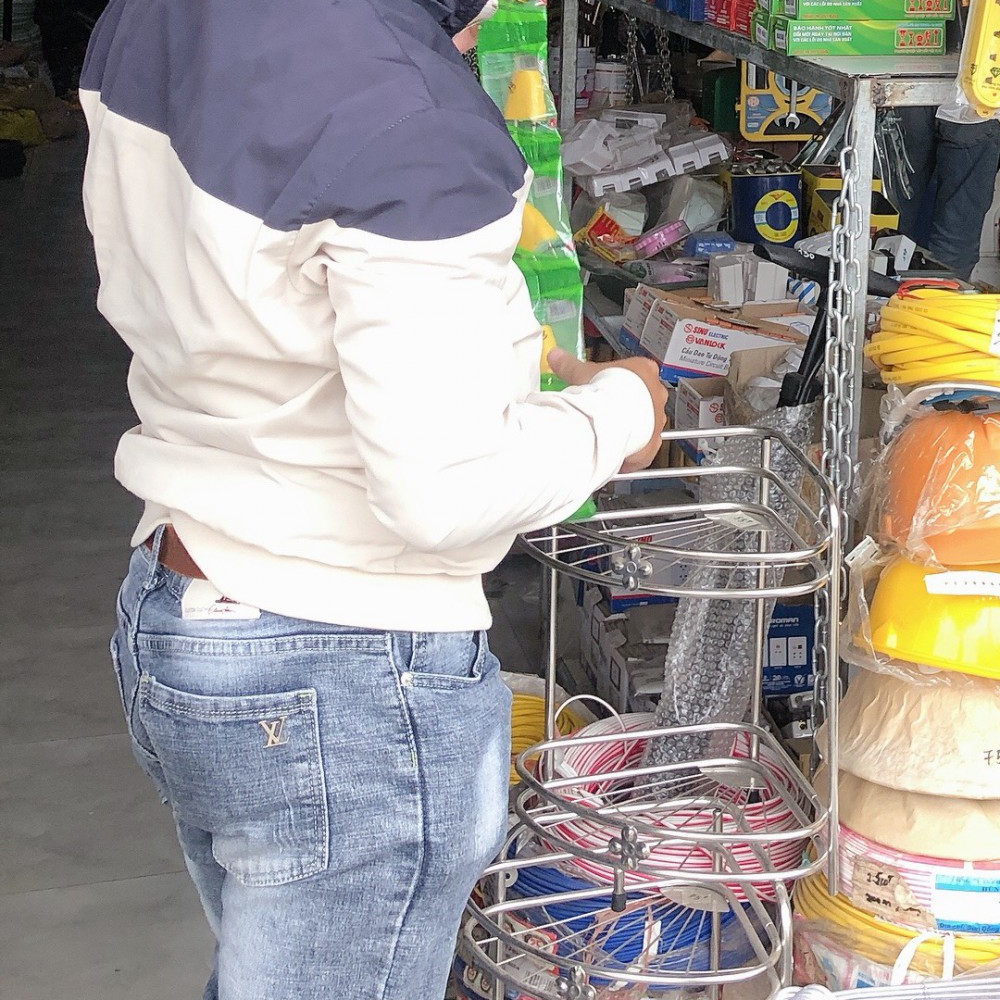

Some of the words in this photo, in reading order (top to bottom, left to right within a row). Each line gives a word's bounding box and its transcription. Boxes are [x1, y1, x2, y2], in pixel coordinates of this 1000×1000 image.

[692, 326, 709, 336] SINO
[708, 331, 729, 341] ELECTRIC
[695, 337, 726, 350] VANLOCK
[693, 349, 705, 358] Dao
